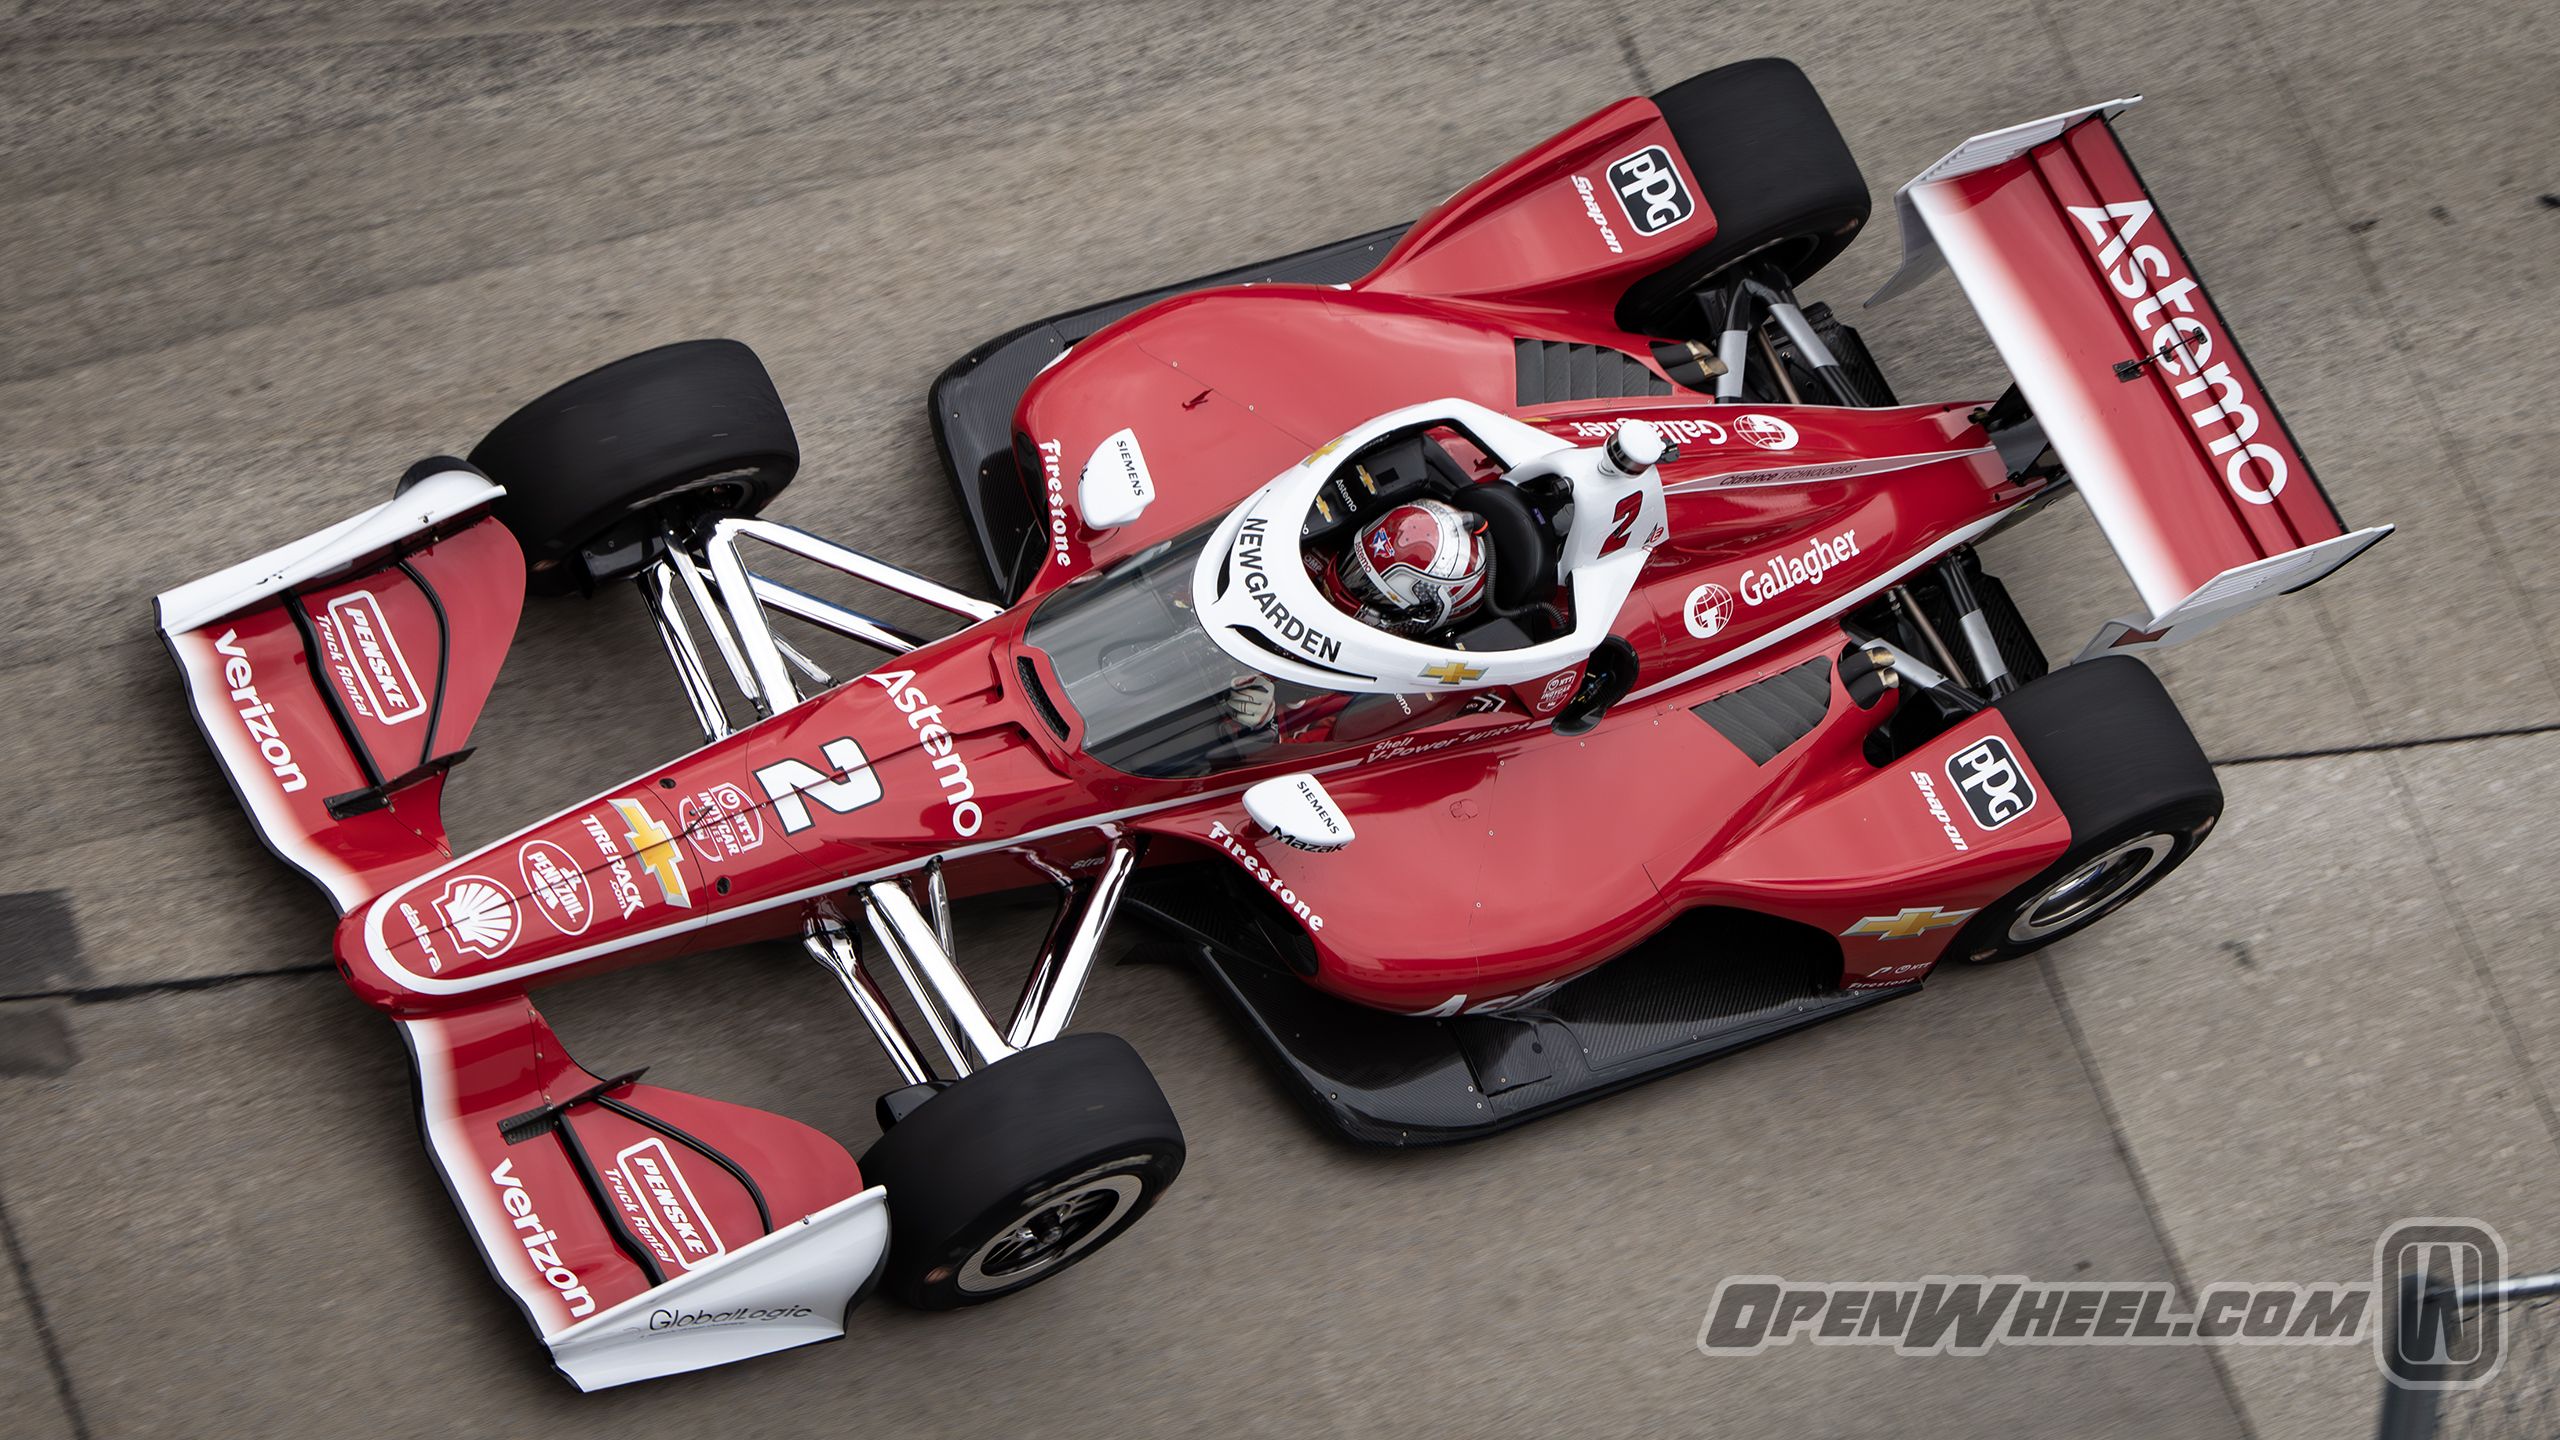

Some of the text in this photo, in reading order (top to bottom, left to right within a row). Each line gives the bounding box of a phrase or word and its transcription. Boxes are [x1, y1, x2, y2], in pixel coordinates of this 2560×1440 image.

[1571, 174, 1623, 253] Snap-on
[1619, 153, 1682, 229] PPG
[2067, 199, 2288, 505] Astemo
[1039, 438, 1071, 567] Firestone
[1116, 440, 1144, 496] SIEMENS
[1336, 478, 1357, 512] Astemo
[1354, 540, 1372, 573] Astemo
[1596, 489, 1643, 560] 2
[1239, 518, 1342, 663] NEWGARDEN
[1739, 528, 1861, 606] Gallagher
[316, 614, 374, 717] Truck Rental
[344, 607, 410, 709] PENSKE
[214, 628, 308, 793] verizon
[1373, 736, 1415, 753] Shell
[752, 735, 885, 836] 2
[866, 669, 983, 837] Astemo
[1367, 737, 1459, 764] V-Power
[1957, 744, 2024, 822] PPG
[734, 813, 757, 843] NTT
[1268, 825, 1344, 853] Mazak
[1296, 781, 1340, 834] SIEMENS
[1910, 771, 1969, 851] Snap-on
[609, 880, 628, 909] .com
[1208, 820, 1323, 931] Firestone
[399, 902, 442, 974] dallara
[1848, 977, 1916, 989] Firestone
[490, 1157, 596, 1318] verizon
[604, 1168, 675, 1264] Truck Rental
[633, 1157, 709, 1254] PENSKE
[649, 1304, 812, 1332] GlobalLogic
